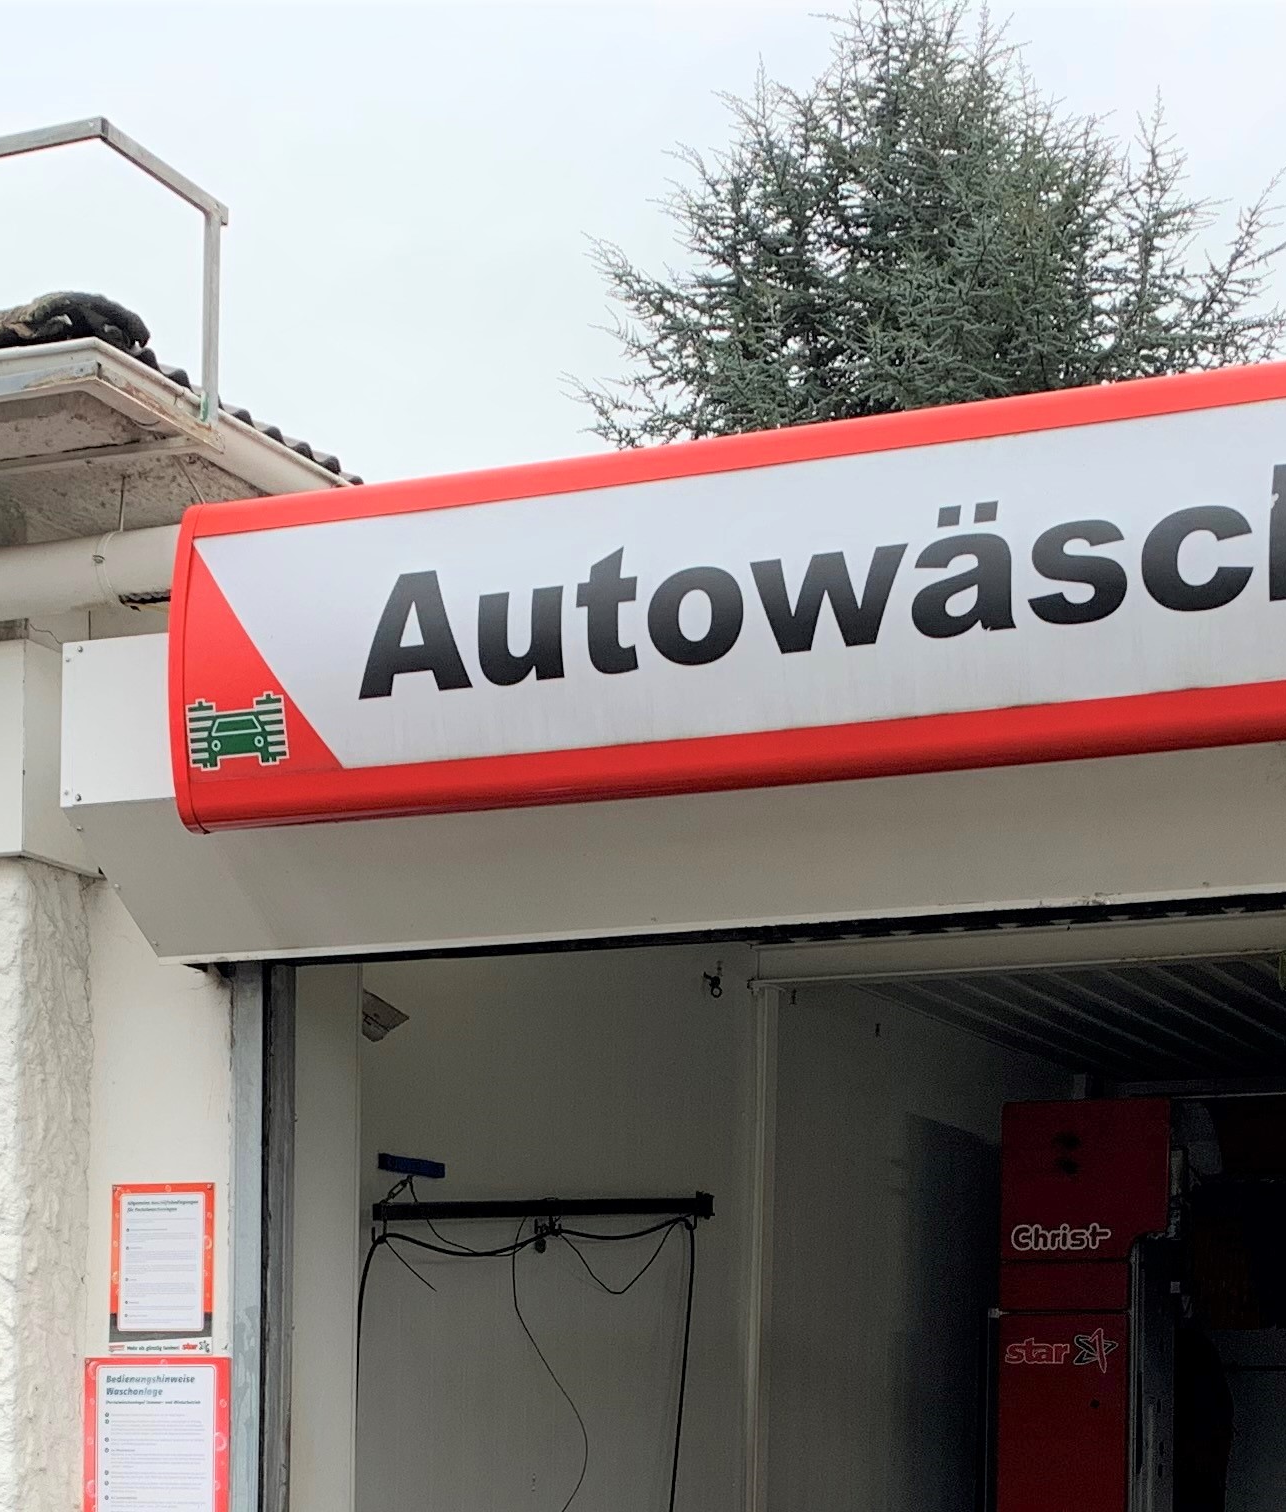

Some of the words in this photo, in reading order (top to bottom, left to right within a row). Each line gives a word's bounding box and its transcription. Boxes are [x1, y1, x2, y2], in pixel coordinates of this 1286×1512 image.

[1011, 1223, 1112, 1251] Christ
[1005, 1337, 1070, 1364] star
[105, 1373, 196, 1386] Bedienungshinweise
[105, 1387, 164, 1397] Waschanlage
